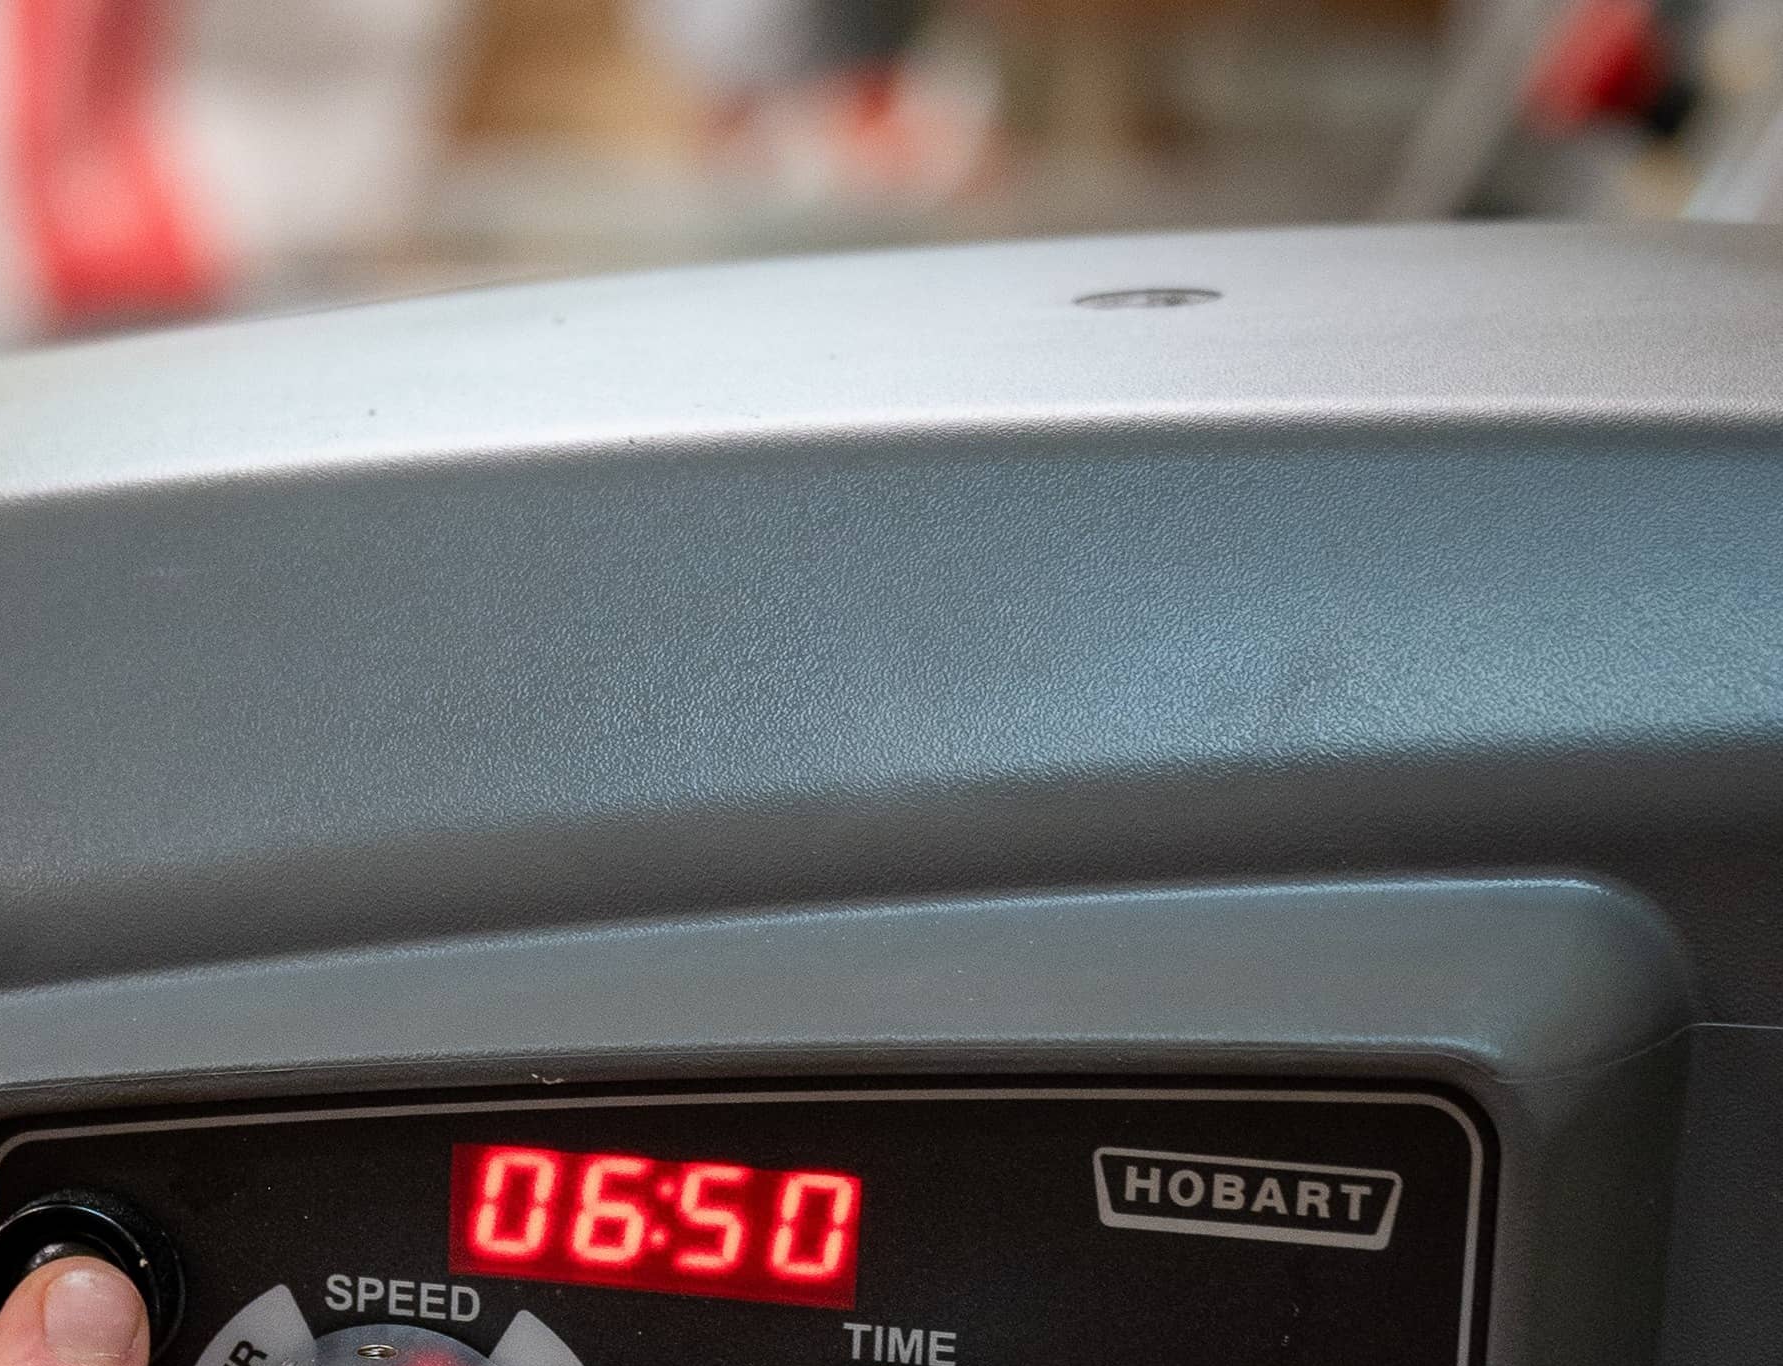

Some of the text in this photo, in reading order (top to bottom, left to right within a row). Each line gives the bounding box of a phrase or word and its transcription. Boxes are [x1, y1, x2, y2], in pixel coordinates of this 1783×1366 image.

[471, 1148, 855, 1277] 06:50
[1123, 1165, 1373, 1223] HOBART
[324, 1274, 481, 1322] SPEED
